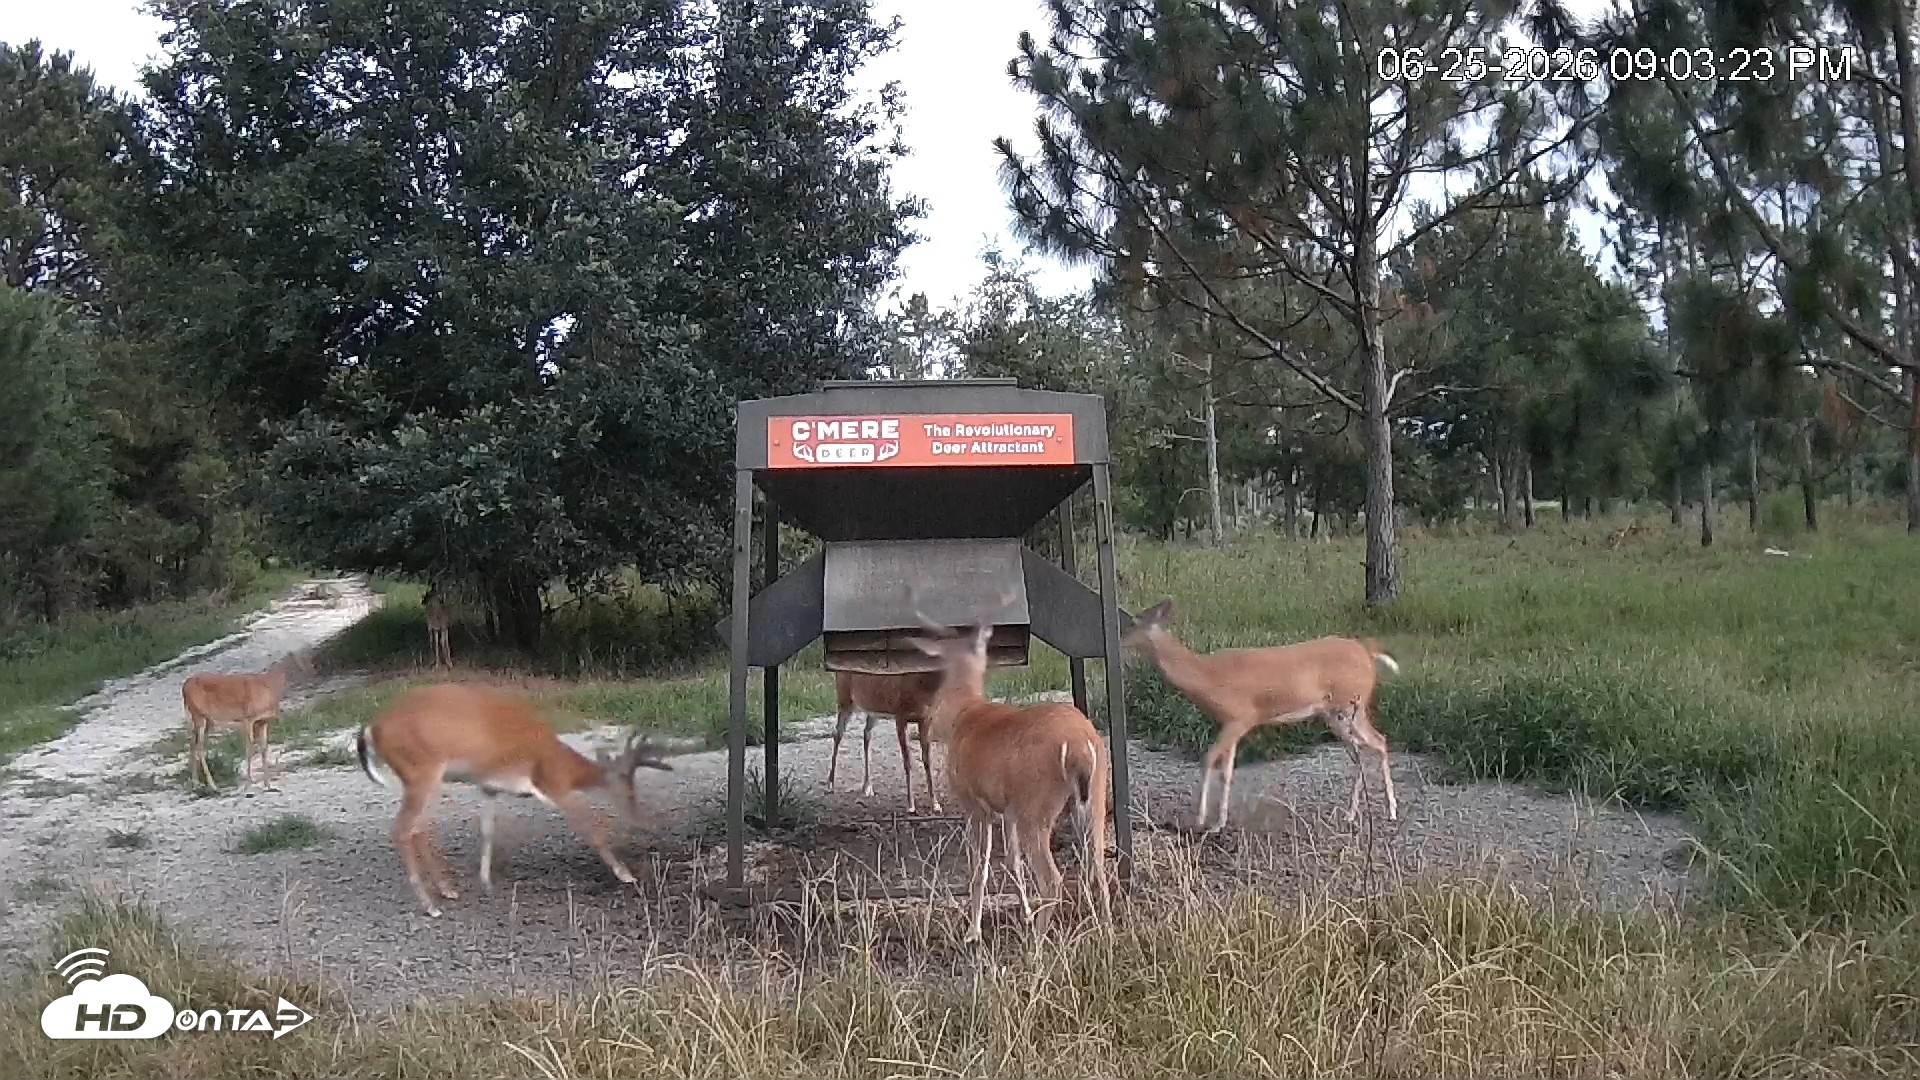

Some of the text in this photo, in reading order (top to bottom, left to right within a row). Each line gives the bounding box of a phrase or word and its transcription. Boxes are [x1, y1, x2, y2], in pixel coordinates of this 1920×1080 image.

[792, 419, 900, 441] C'MERE
[923, 422, 1055, 438] The Revolutionary
[820, 447, 871, 459] DEER
[931, 440, 1044, 454] Deer Attractant
